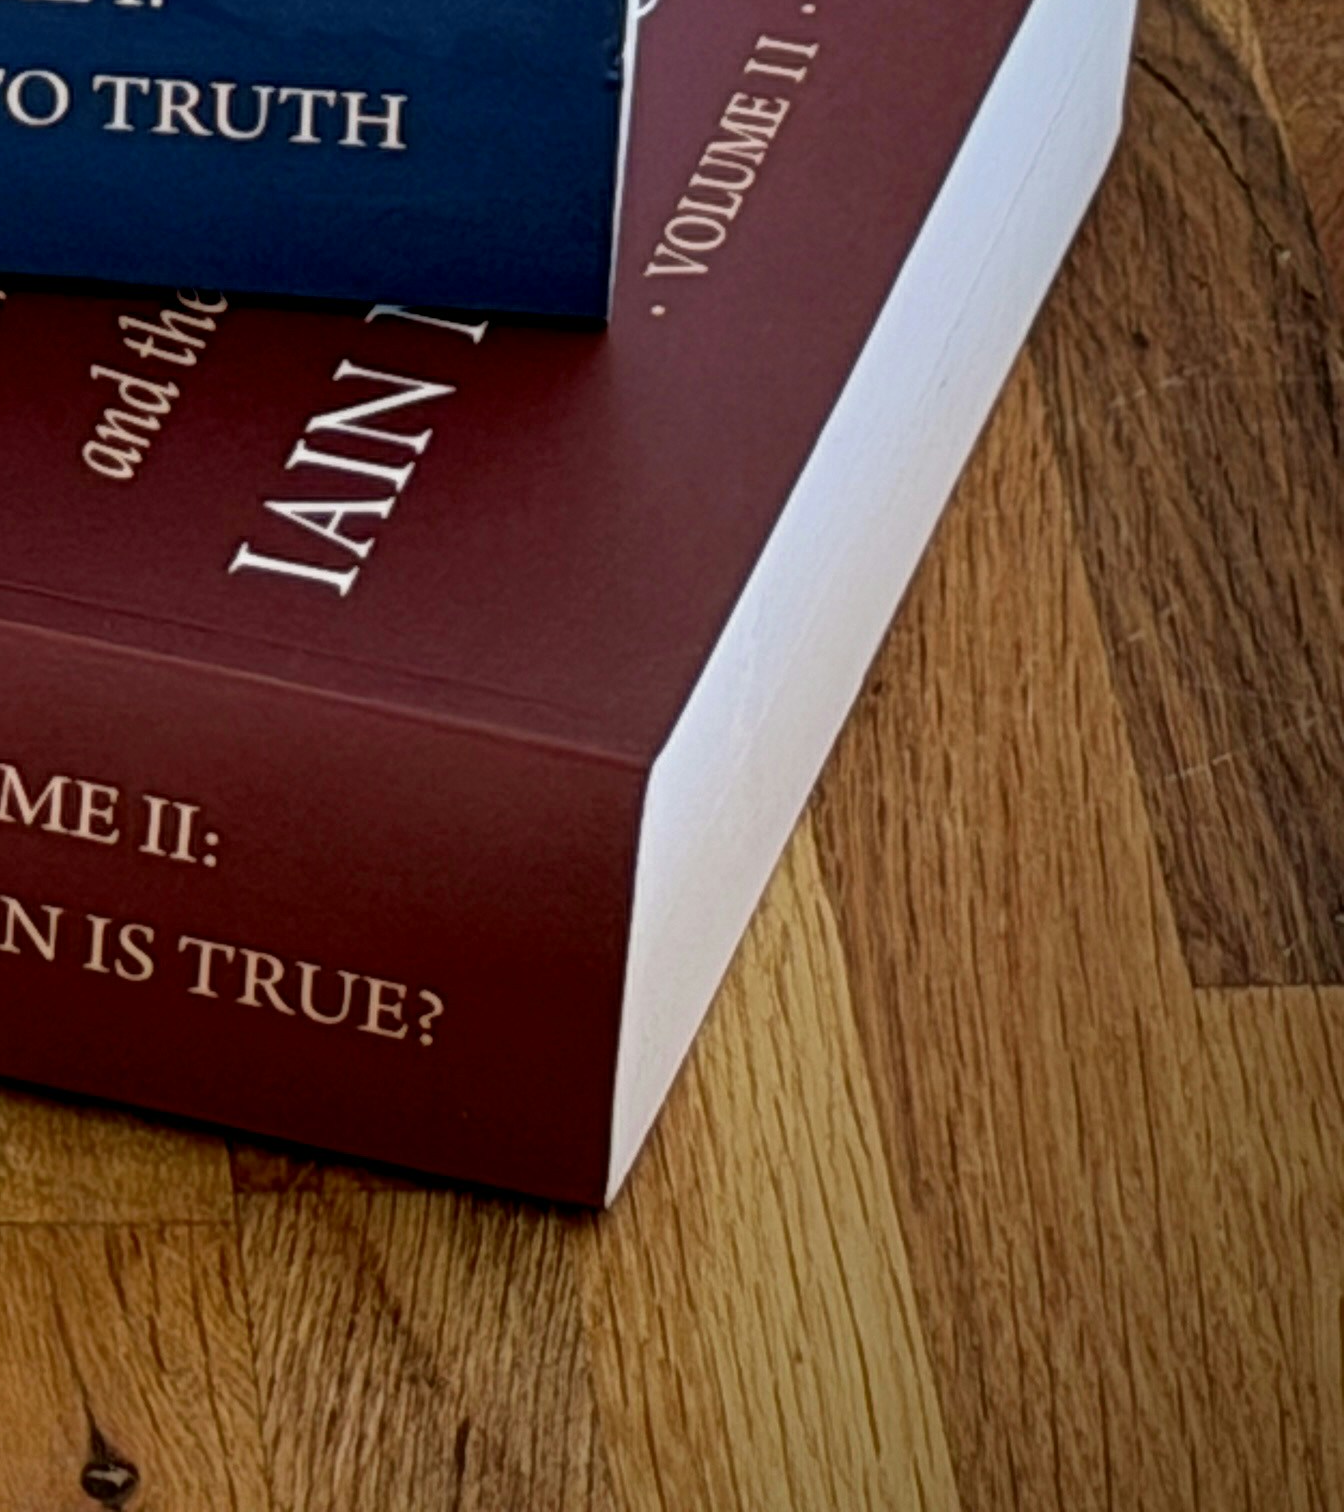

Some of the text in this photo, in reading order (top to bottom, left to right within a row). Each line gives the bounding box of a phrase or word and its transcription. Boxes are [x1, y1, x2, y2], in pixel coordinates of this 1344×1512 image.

[92, 74, 406, 149] TRUTH
[644, 35, 819, 276] VOLUME II
[82, 364, 180, 479] and
[227, 358, 457, 597] IAIN
[140, 795, 219, 867] II:
[84, 914, 154, 981] IS
[178, 935, 444, 1045] TRUE?
